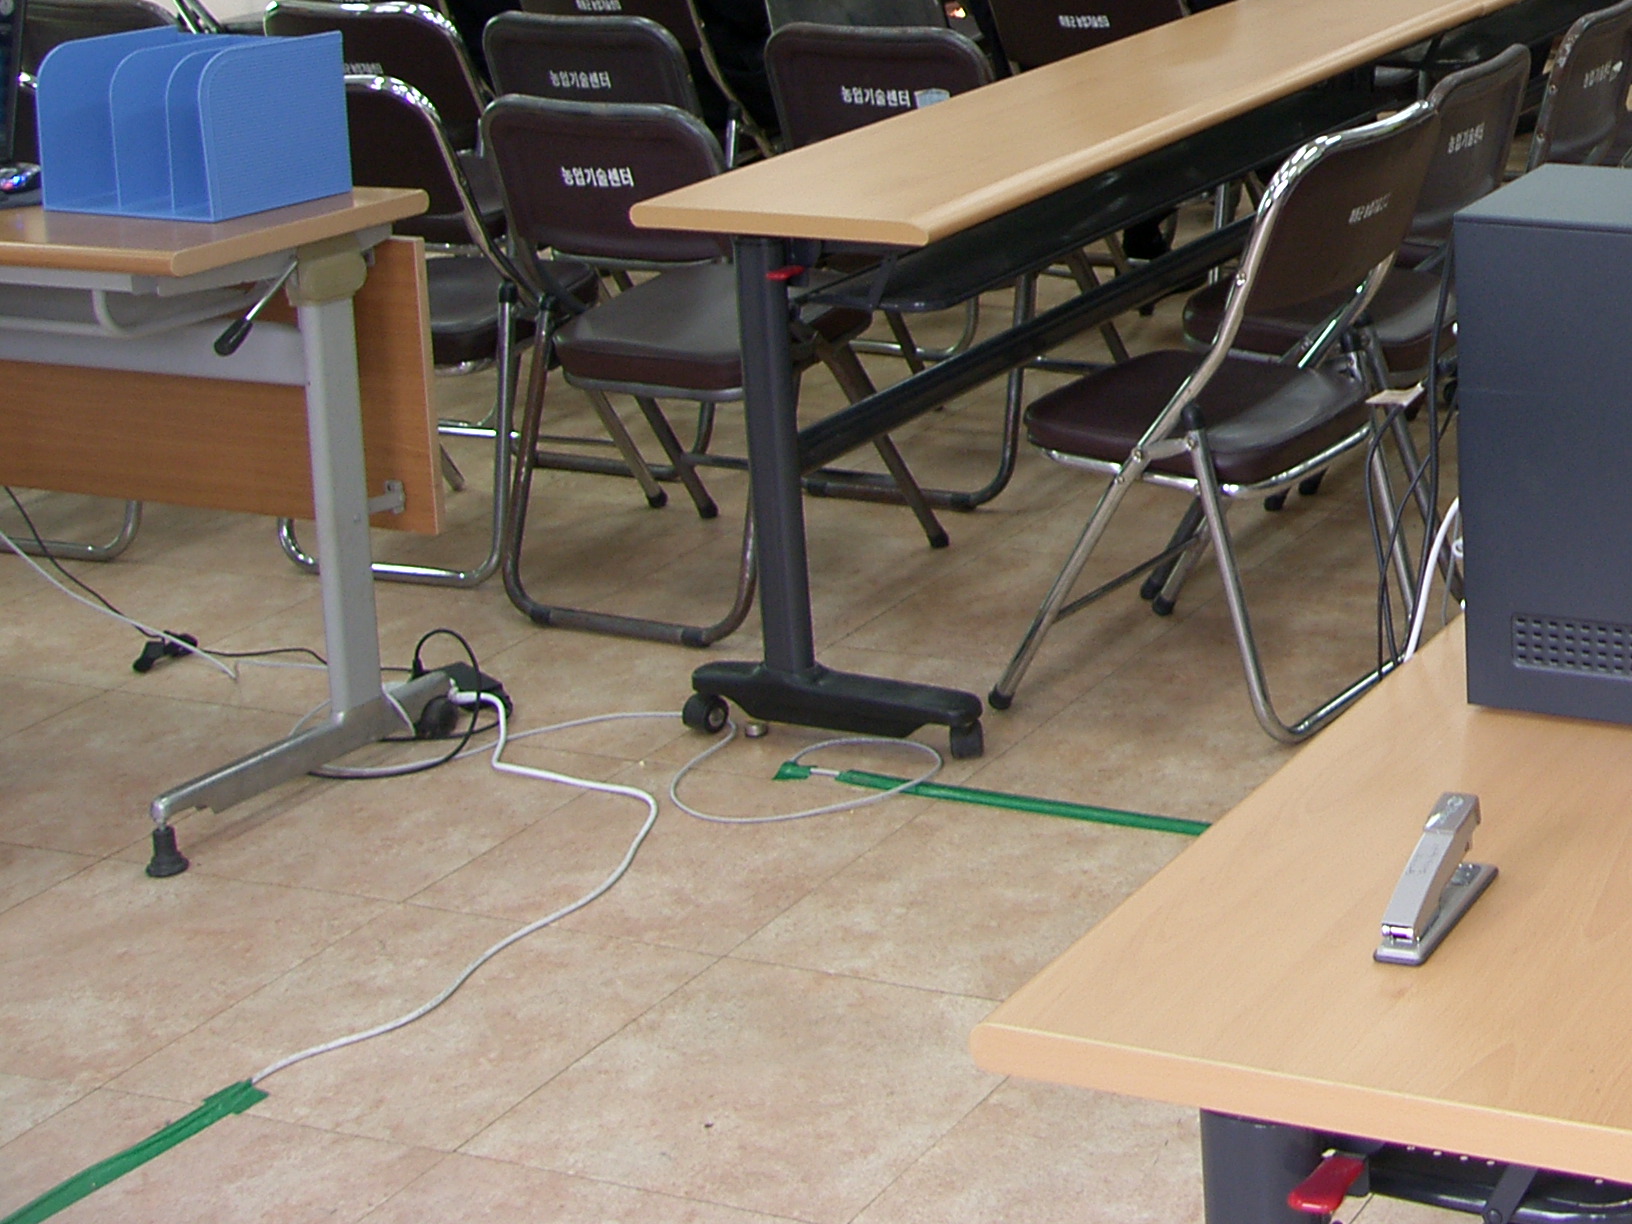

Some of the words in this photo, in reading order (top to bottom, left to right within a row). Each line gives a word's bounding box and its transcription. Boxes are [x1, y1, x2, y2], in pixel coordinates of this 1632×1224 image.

[549, 69, 612, 89] 농업기술센터
[840, 84, 911, 109] 농업기술센터
[561, 165, 635, 189] 농업기술센터
